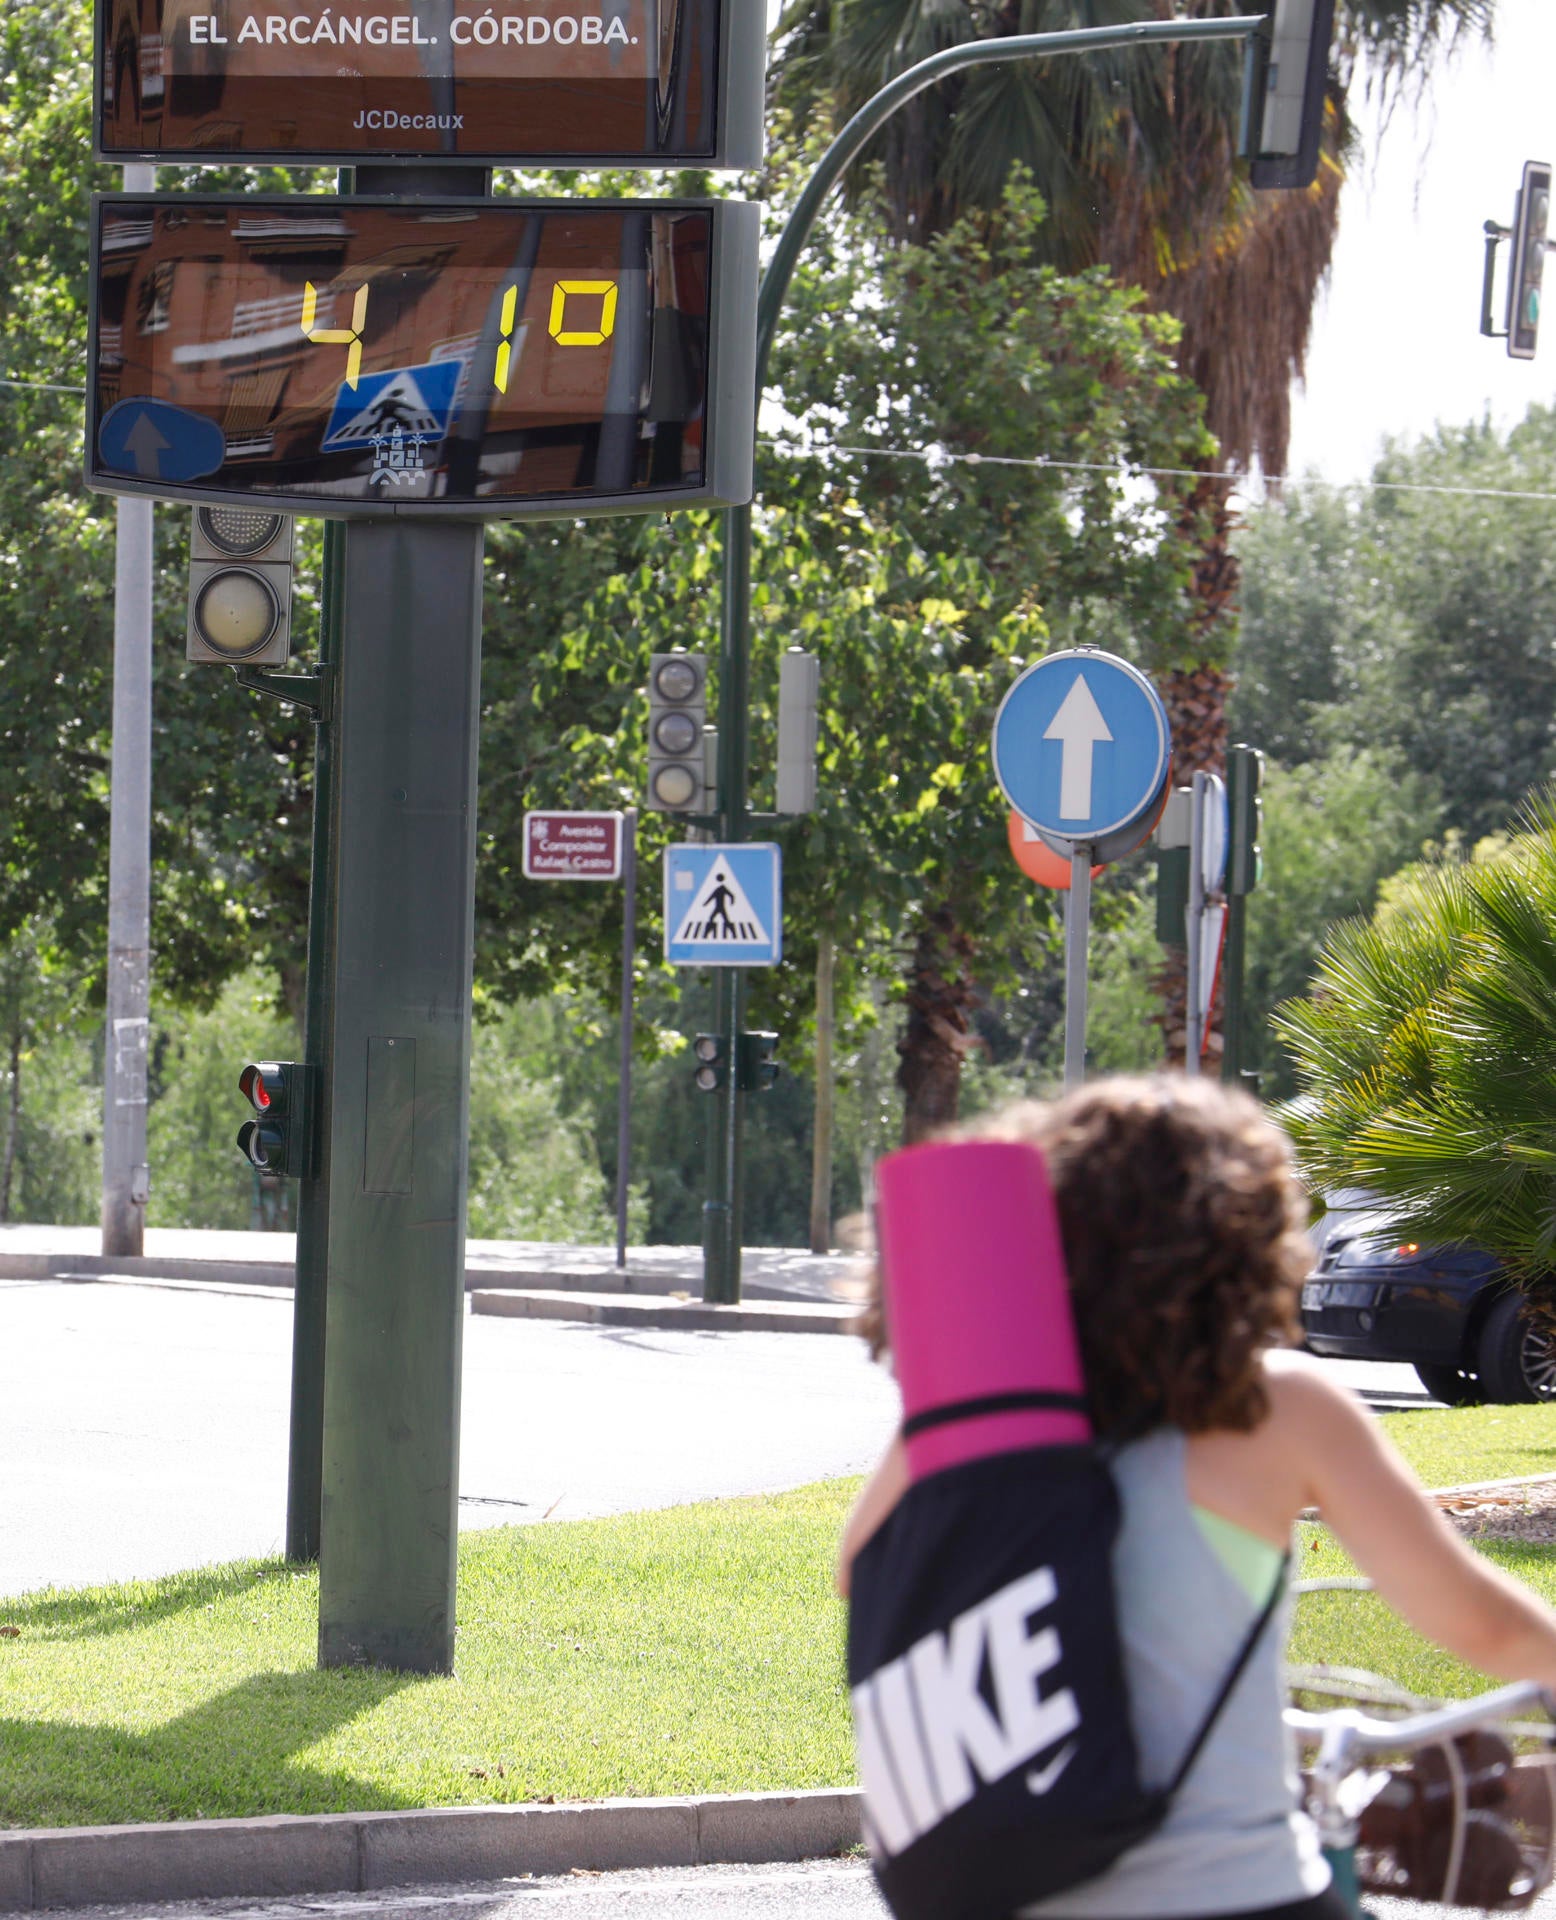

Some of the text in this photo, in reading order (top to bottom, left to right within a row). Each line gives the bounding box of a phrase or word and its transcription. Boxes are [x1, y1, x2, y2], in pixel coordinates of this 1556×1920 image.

[189, 8, 639, 45] EL ARCÁNGEL. CÓRDOBA.
[352, 110, 463, 130] JCDecaux
